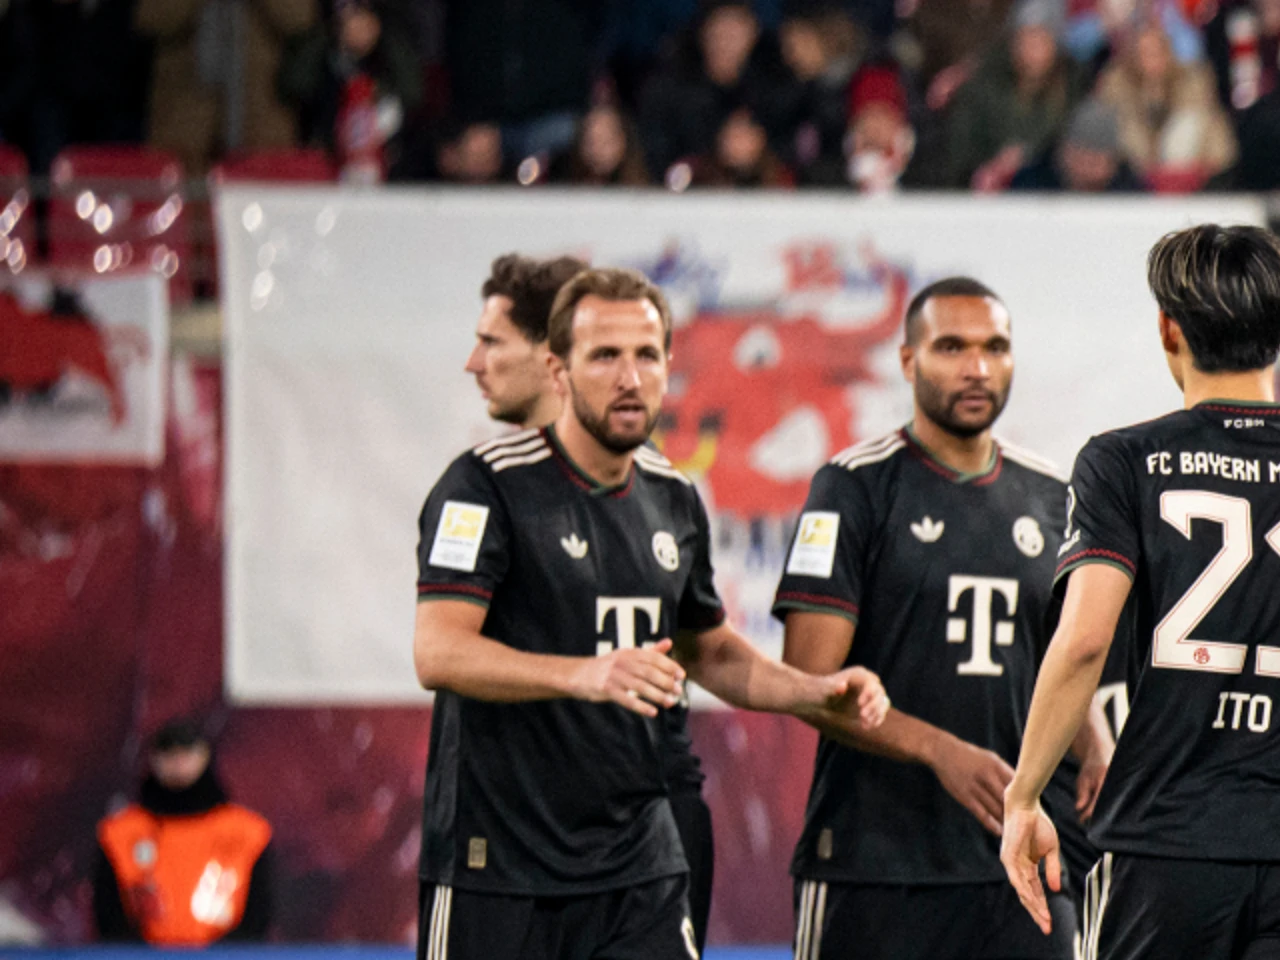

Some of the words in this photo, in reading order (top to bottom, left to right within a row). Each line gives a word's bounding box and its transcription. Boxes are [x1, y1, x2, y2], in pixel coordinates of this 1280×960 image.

[1146, 451, 1173, 475] FC
[1180, 451, 1260, 482] BAYERN
[1212, 692, 1272, 732] ITO
